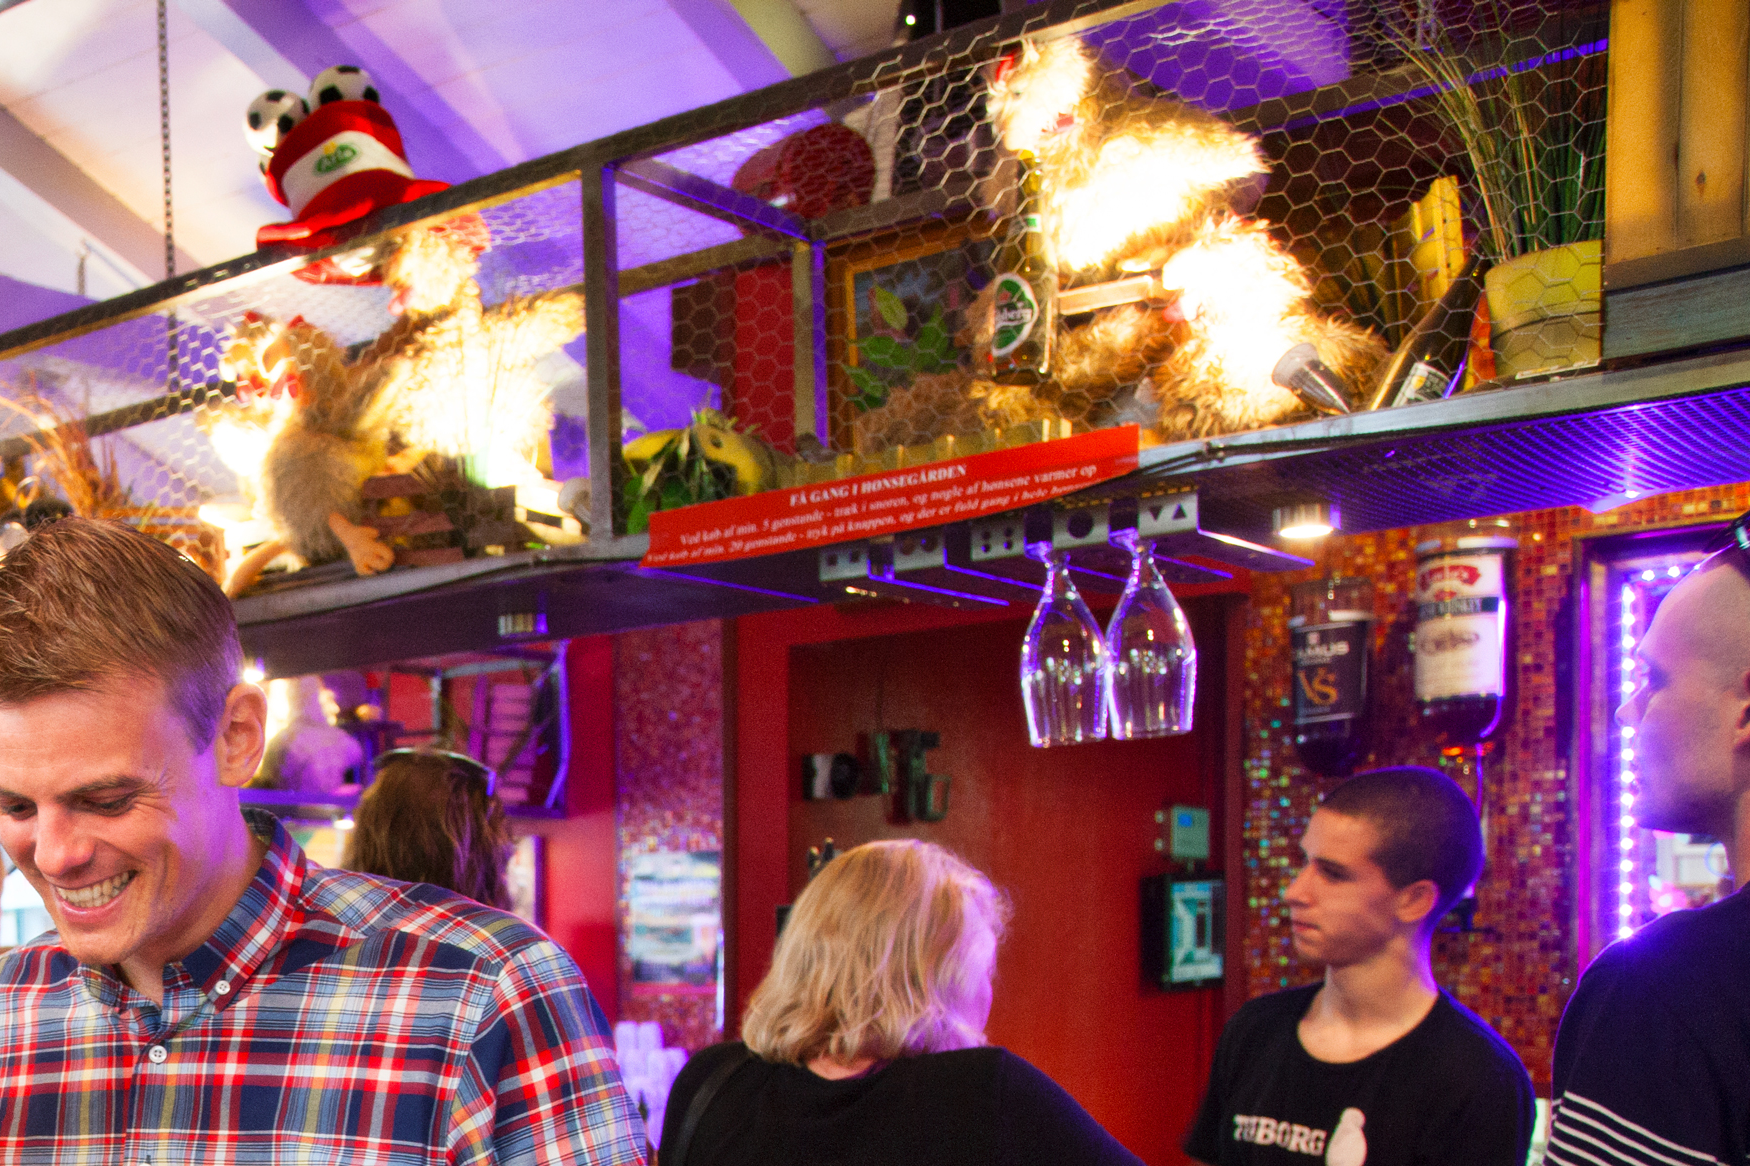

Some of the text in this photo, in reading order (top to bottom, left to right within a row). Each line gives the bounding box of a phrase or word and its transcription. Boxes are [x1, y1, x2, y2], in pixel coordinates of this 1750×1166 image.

[680, 532, 700, 546] Ved
[912, 492, 928, 506] og
[1079, 464, 1097, 479] op
[810, 486, 849, 504] GANG
